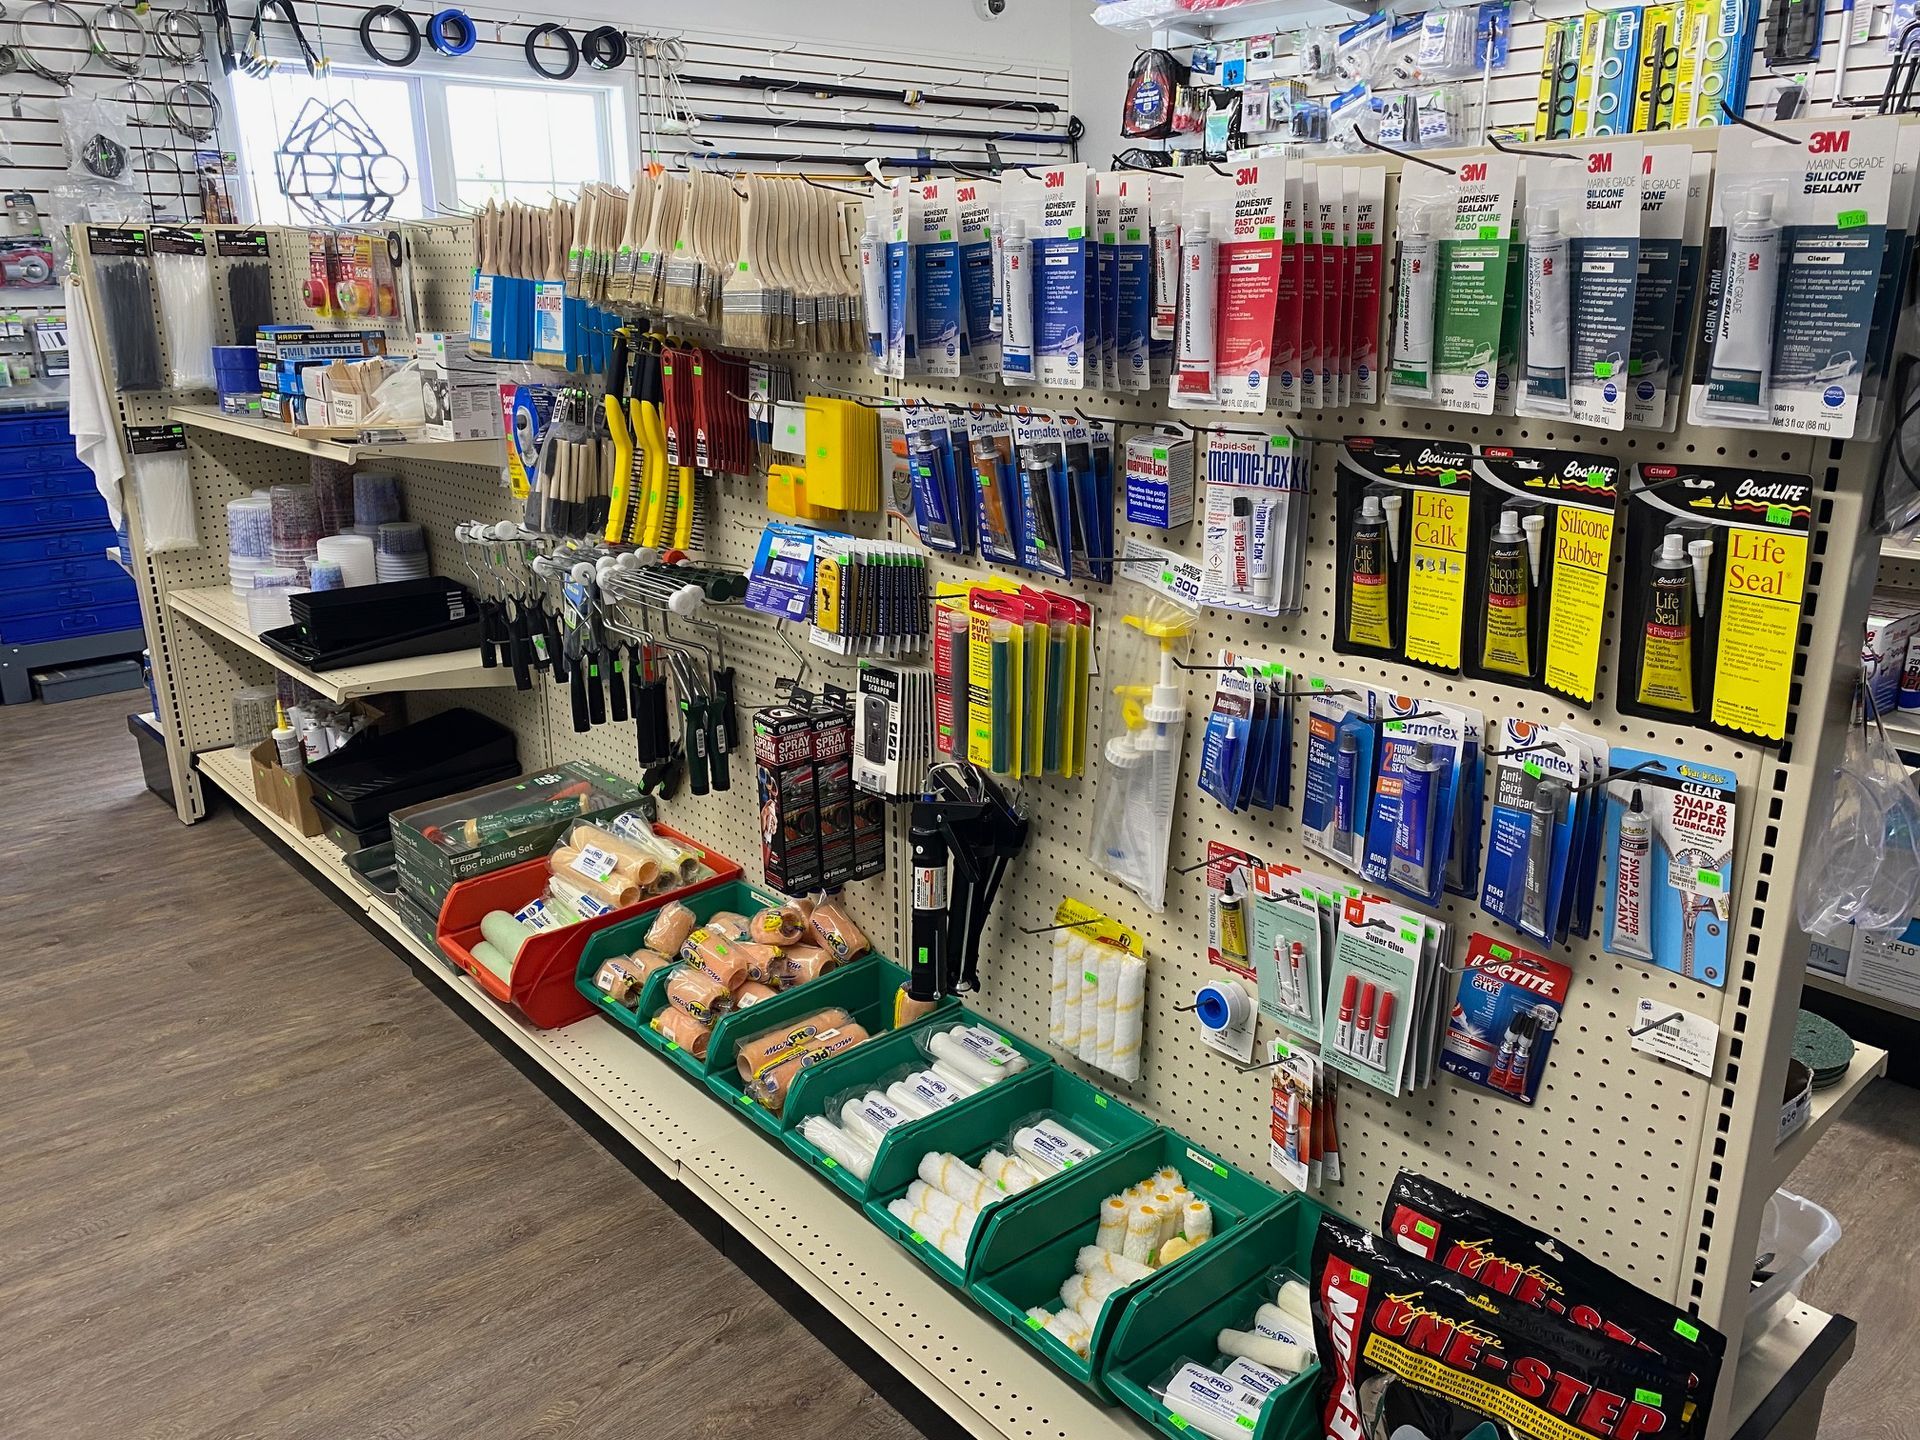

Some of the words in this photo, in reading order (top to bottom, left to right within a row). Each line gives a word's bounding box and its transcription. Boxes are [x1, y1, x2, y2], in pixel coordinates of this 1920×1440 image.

[1808, 130, 1851, 154] 3M
[1587, 153, 1612, 173] 3M
[1806, 157, 1846, 170] MARINE
[1848, 156, 1885, 169] GRADE
[1045, 171, 1065, 188] 3M
[1236, 167, 1258, 186] 3M
[1460, 164, 1487, 182] 3M
[1804, 170, 1866, 182] SILICONE
[1611, 176, 1635, 187] GRADE
[1803, 183, 1862, 194] SEALANT
[922, 185, 938, 200] 3M
[956, 186, 976, 201] 3M
[1458, 194, 1499, 204] ADHESIVE
[1587, 189, 1624, 198] SILICONE
[1045, 201, 1076, 210] ADHESIVE
[1235, 197, 1273, 208] ADHESIVE
[1457, 204, 1494, 213] SEALANT
[1586, 200, 1622, 210] SEALANT
[924, 208, 949, 217] ADHESIVE
[1045, 209, 1072, 218] SEALANT
[1235, 207, 1268, 217] SEALANT
[1456, 214, 1475, 223] FAST
[1477, 213, 1501, 223] CURE
[924, 216, 947, 225] SEALANT
[1045, 218, 1062, 227] 5200
[1234, 217, 1252, 227] FAST
[1254, 215, 1275, 225] CURE
[1455, 222, 1477, 231] 4200
[1234, 226, 1255, 235] 5200
[1011, 255, 1019, 270] 3M
[1191, 254, 1199, 270] 3M
[1412, 259, 1421, 273] 3M
[1543, 257, 1553, 276] 3M
[1748, 253, 1759, 271] 3M
[1726, 251, 1737, 297] SILICONE
[1710, 268, 1722, 297] TRIM
[1709, 299, 1718, 308] &
[1704, 309, 1715, 343] CABIN
[1721, 298, 1732, 340] SEALANT
[277, 333, 303, 341] HARDY
[310, 345, 362, 355] NITRILE
[1774, 404, 1795, 412] 08019
[905, 415, 948, 430] Permatex
[971, 419, 1009, 435] Permatex
[1017, 426, 1061, 440] Permatex
[1210, 441, 1256, 452] Rapid-Set
[1127, 455, 1167, 477] marine-tex
[1135, 454, 1152, 462] WHITE
[1208, 441, 1289, 488] marine-tex
[1154, 490, 1167, 498] putty
[1736, 478, 1805, 501] BoatLIFE
[1152, 502, 1165, 511] wood
[1416, 495, 1454, 520] Life
[1560, 511, 1609, 541] Silicone
[1415, 522, 1457, 548] Calk
[1355, 544, 1373, 560] Life
[1557, 537, 1603, 568] Rubber
[1733, 533, 1786, 563] Life
[1234, 534, 1247, 592] marine-tex
[1354, 558, 1372, 574] Calk
[1175, 577, 1199, 596] 300
[1657, 576, 1687, 584] BoatLIFE
[1729, 565, 1783, 595] Seal
[1655, 591, 1679, 610] Life
[1655, 608, 1679, 627] Seal
[863, 674, 880, 685] RAZOR
[881, 678, 895, 690] BLADE
[868, 683, 890, 696] SCRAPER
[1388, 721, 1458, 741] ermatex
[754, 735, 776, 753] SPRAY
[778, 736, 810, 753] SPRAY
[816, 732, 846, 749] SPRAY
[1310, 739, 1326, 750] Form-
[779, 748, 810, 762] SYSTEM
[816, 744, 846, 758] SYSTEM
[1382, 742, 1393, 772] 2
[1309, 755, 1331, 769] Sealant
[1504, 745, 1574, 775] Permatex
[1501, 769, 1522, 783] Anti-
[1500, 780, 1522, 795] Seize
[1681, 783, 1722, 800] CLEAR
[1673, 794, 1715, 812] SNAP
[1717, 804, 1728, 817] &
[1673, 806, 1727, 829] ZIPPER
[1672, 818, 1727, 837] LUBRICANT
[1621, 841, 1639, 849] CLEAR
[460, 862, 478, 874] 6pc
[479, 850, 517, 870] Painting
[518, 843, 535, 859] Set
[1628, 858, 1640, 888] SNAP
[1617, 854, 1631, 933] LUBRICANT
[1628, 889, 1638, 897] &
[1627, 897, 1640, 936] ZIPPER
[1365, 931, 1387, 945] Super
[1387, 940, 1405, 954] Glue
[1471, 955, 1555, 997] LOCTITE
[1475, 974, 1503, 988] SUPER
[1472, 981, 1500, 997] GLUE
[1451, 1032, 1471, 1044] LIQUID
[1384, 1291, 1505, 1350] Signature
[1371, 1299, 1668, 1440] ONE-STEP
[1374, 1338, 1424, 1365] RECOMMENDED
[1424, 1360, 1438, 1370] FOR
[1438, 1364, 1460, 1380] PAINT
[1460, 1373, 1485, 1389] SPRAY
[1485, 1384, 1501, 1396] AND
[1501, 1393, 1538, 1415] PESTICIDE
[1210, 1377, 1233, 1392] PRO
[1261, 1373, 1283, 1388] PRO
[1419, 1366, 1436, 1379] PARA
[1481, 1390, 1491, 1400] DE
[1492, 1395, 1520, 1414] PINTURA
[1520, 1409, 1530, 1418] EN
[1531, 1413, 1560, 1433] AEROSOL
